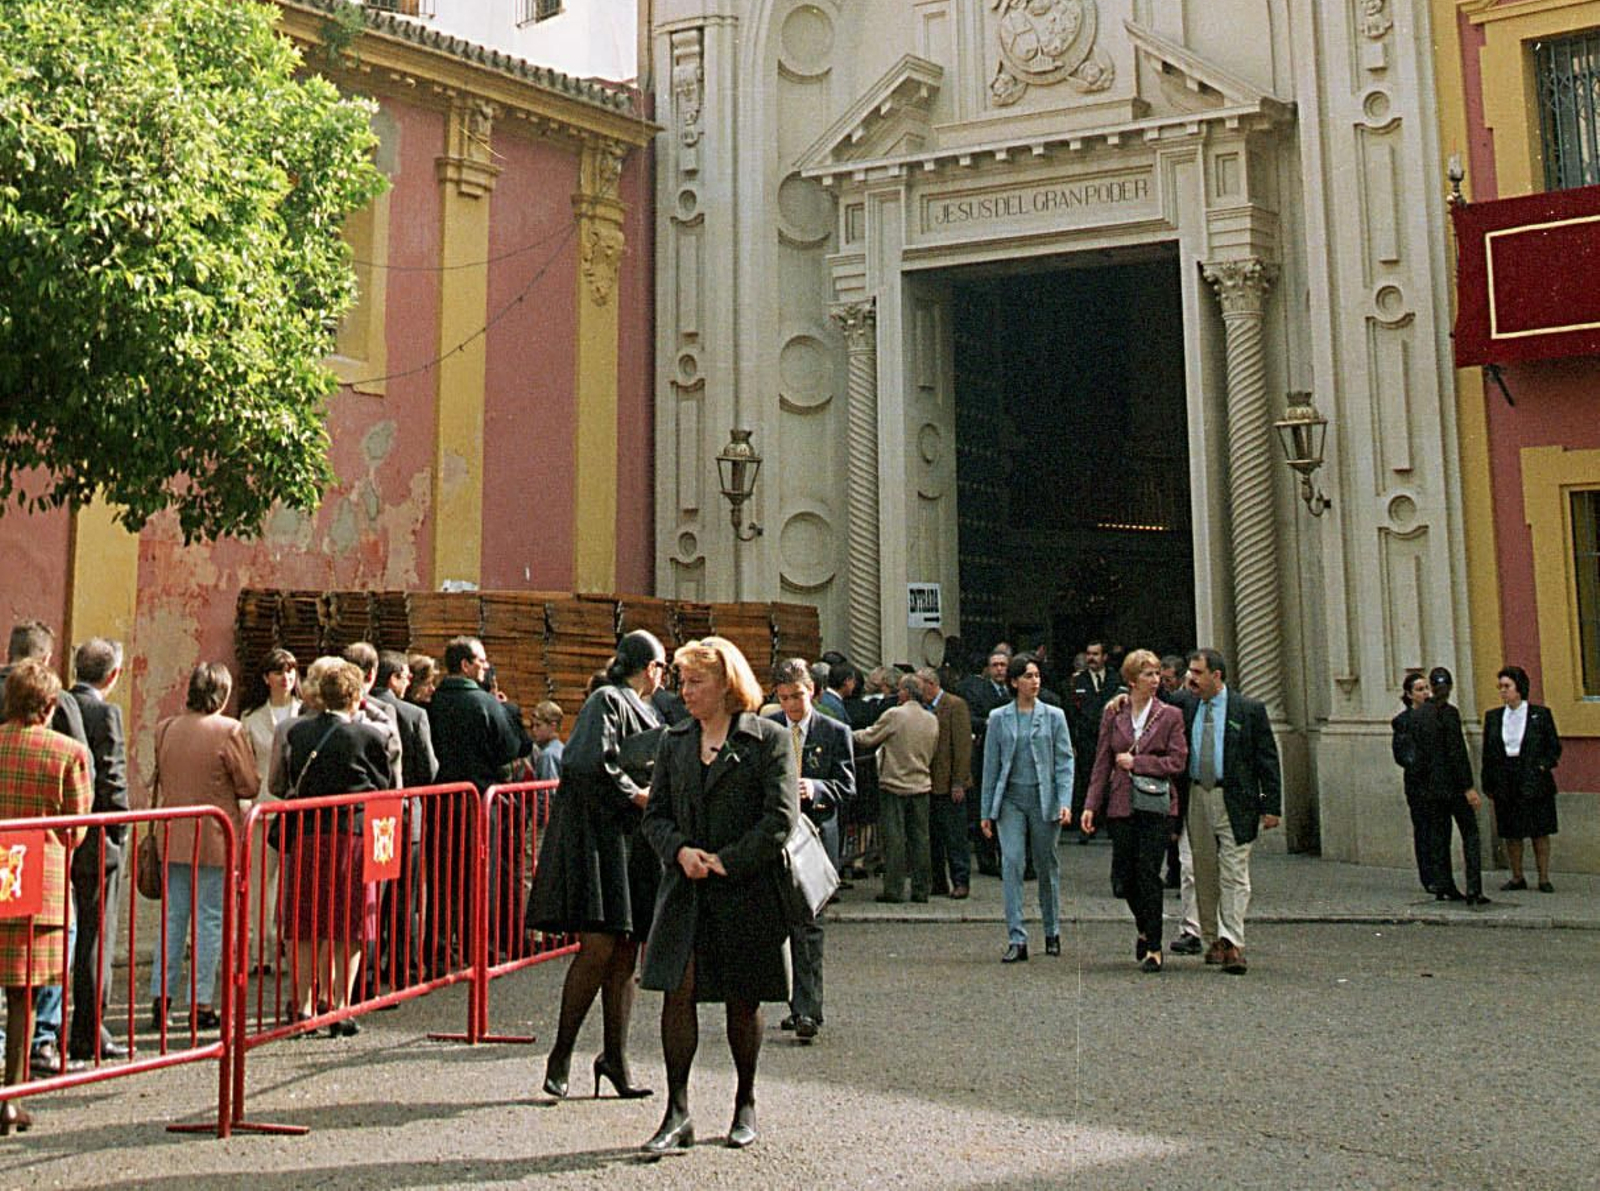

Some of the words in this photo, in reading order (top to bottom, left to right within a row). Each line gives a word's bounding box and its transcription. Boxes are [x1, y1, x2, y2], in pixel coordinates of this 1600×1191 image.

[936, 199, 993, 224] JESUS
[994, 194, 1030, 218] DEL
[1033, 185, 1083, 212] GRAN
[1085, 178, 1150, 205] PODER
[909, 588, 939, 613] ENTRADA
